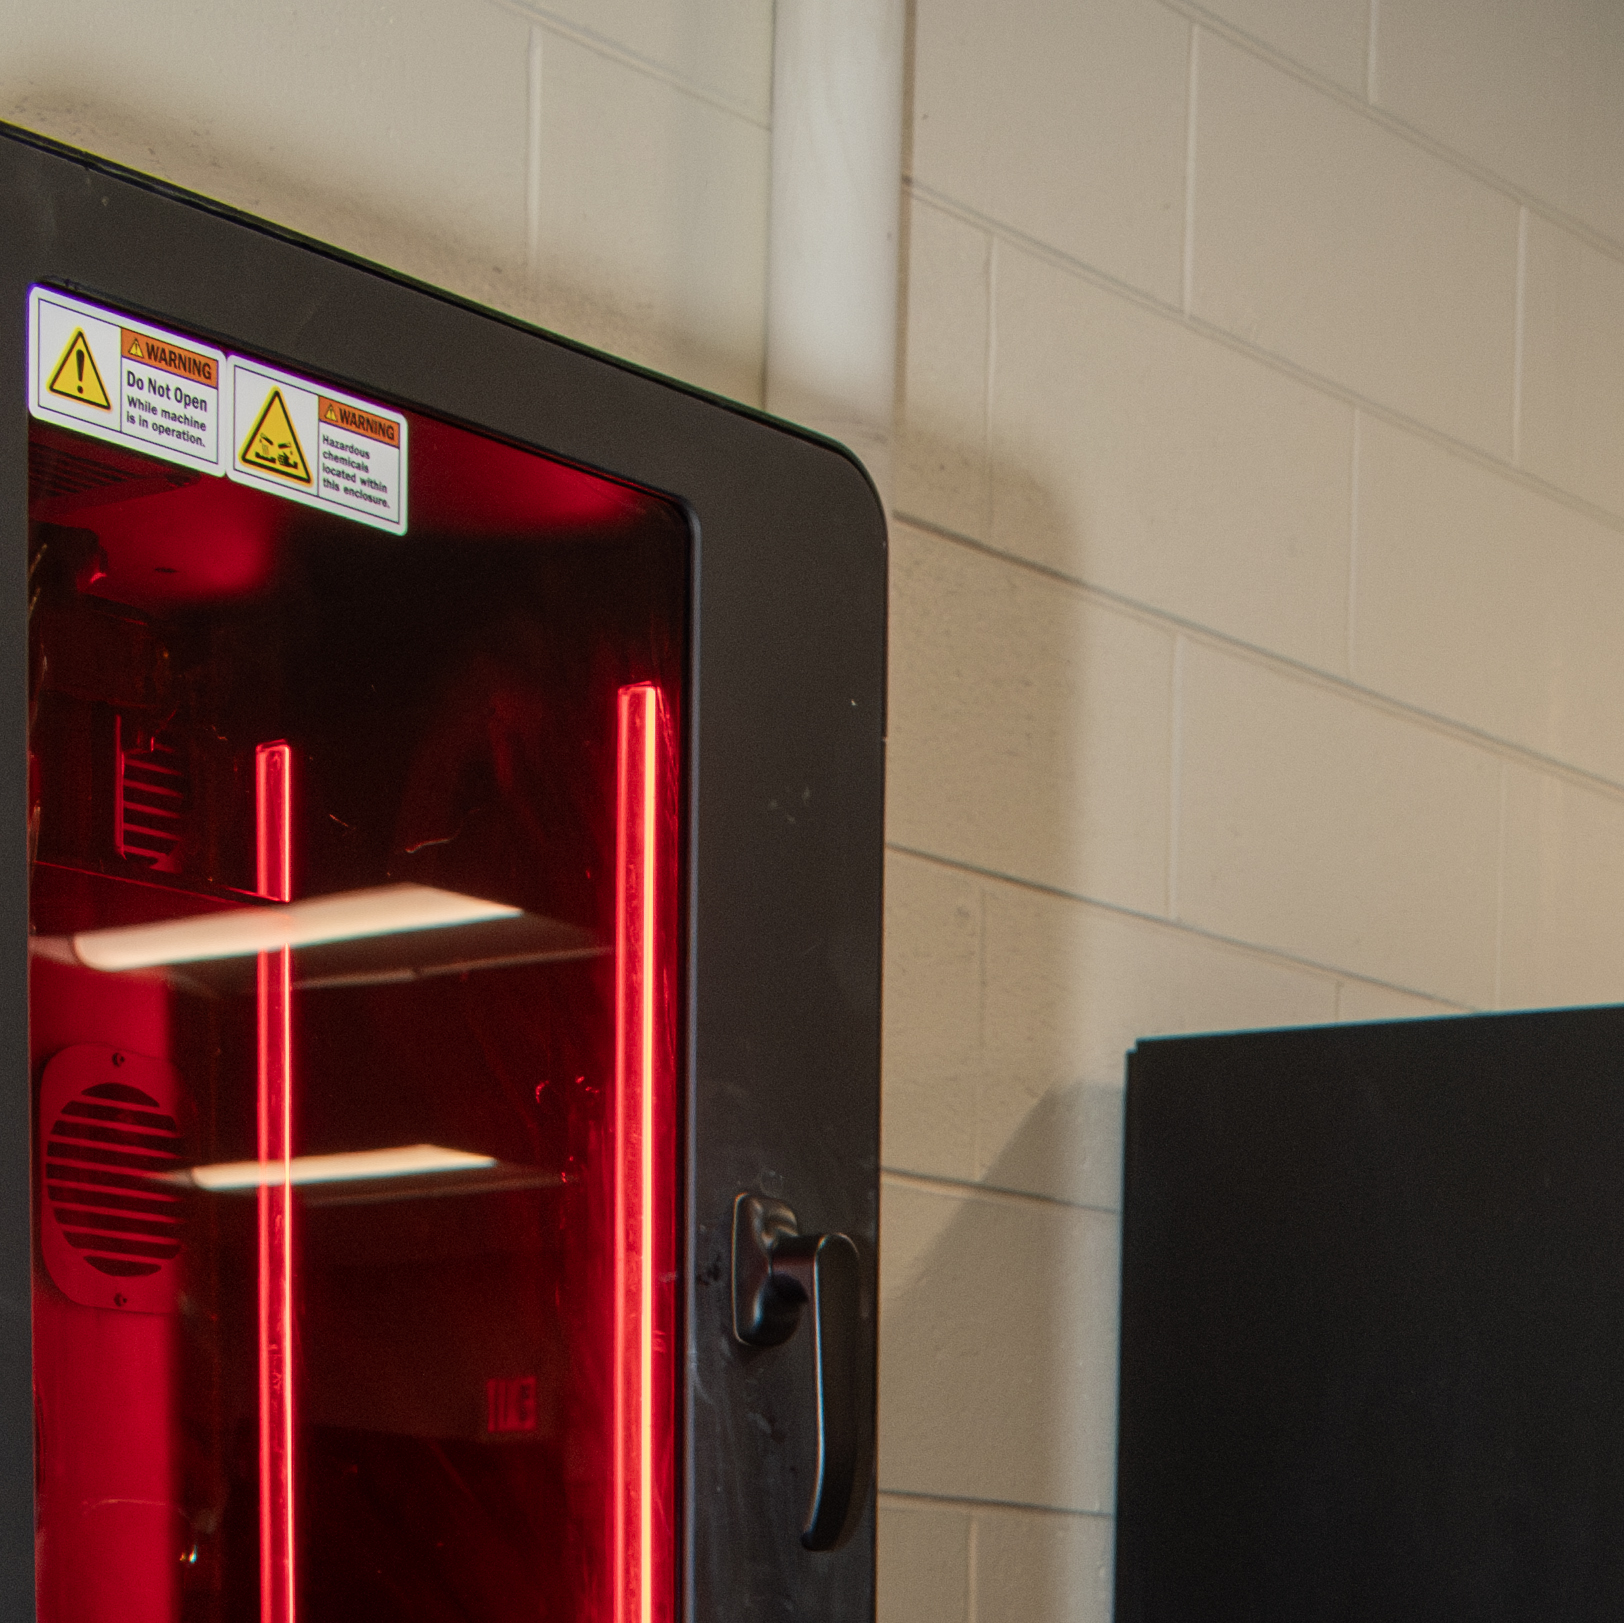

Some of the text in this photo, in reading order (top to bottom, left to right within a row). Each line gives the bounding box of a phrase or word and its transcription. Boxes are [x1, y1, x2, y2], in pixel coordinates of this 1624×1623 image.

[146, 341, 212, 380] WARNING
[127, 370, 208, 413] Do Not Open
[126, 411, 206, 448] is in operation.
[127, 395, 207, 432] While machine
[339, 407, 395, 441] WARNING
[322, 434, 370, 460] Hazardous
[322, 450, 369, 474] chemicals
[322, 462, 388, 493] located within
[323, 478, 391, 509] this enclosure.
